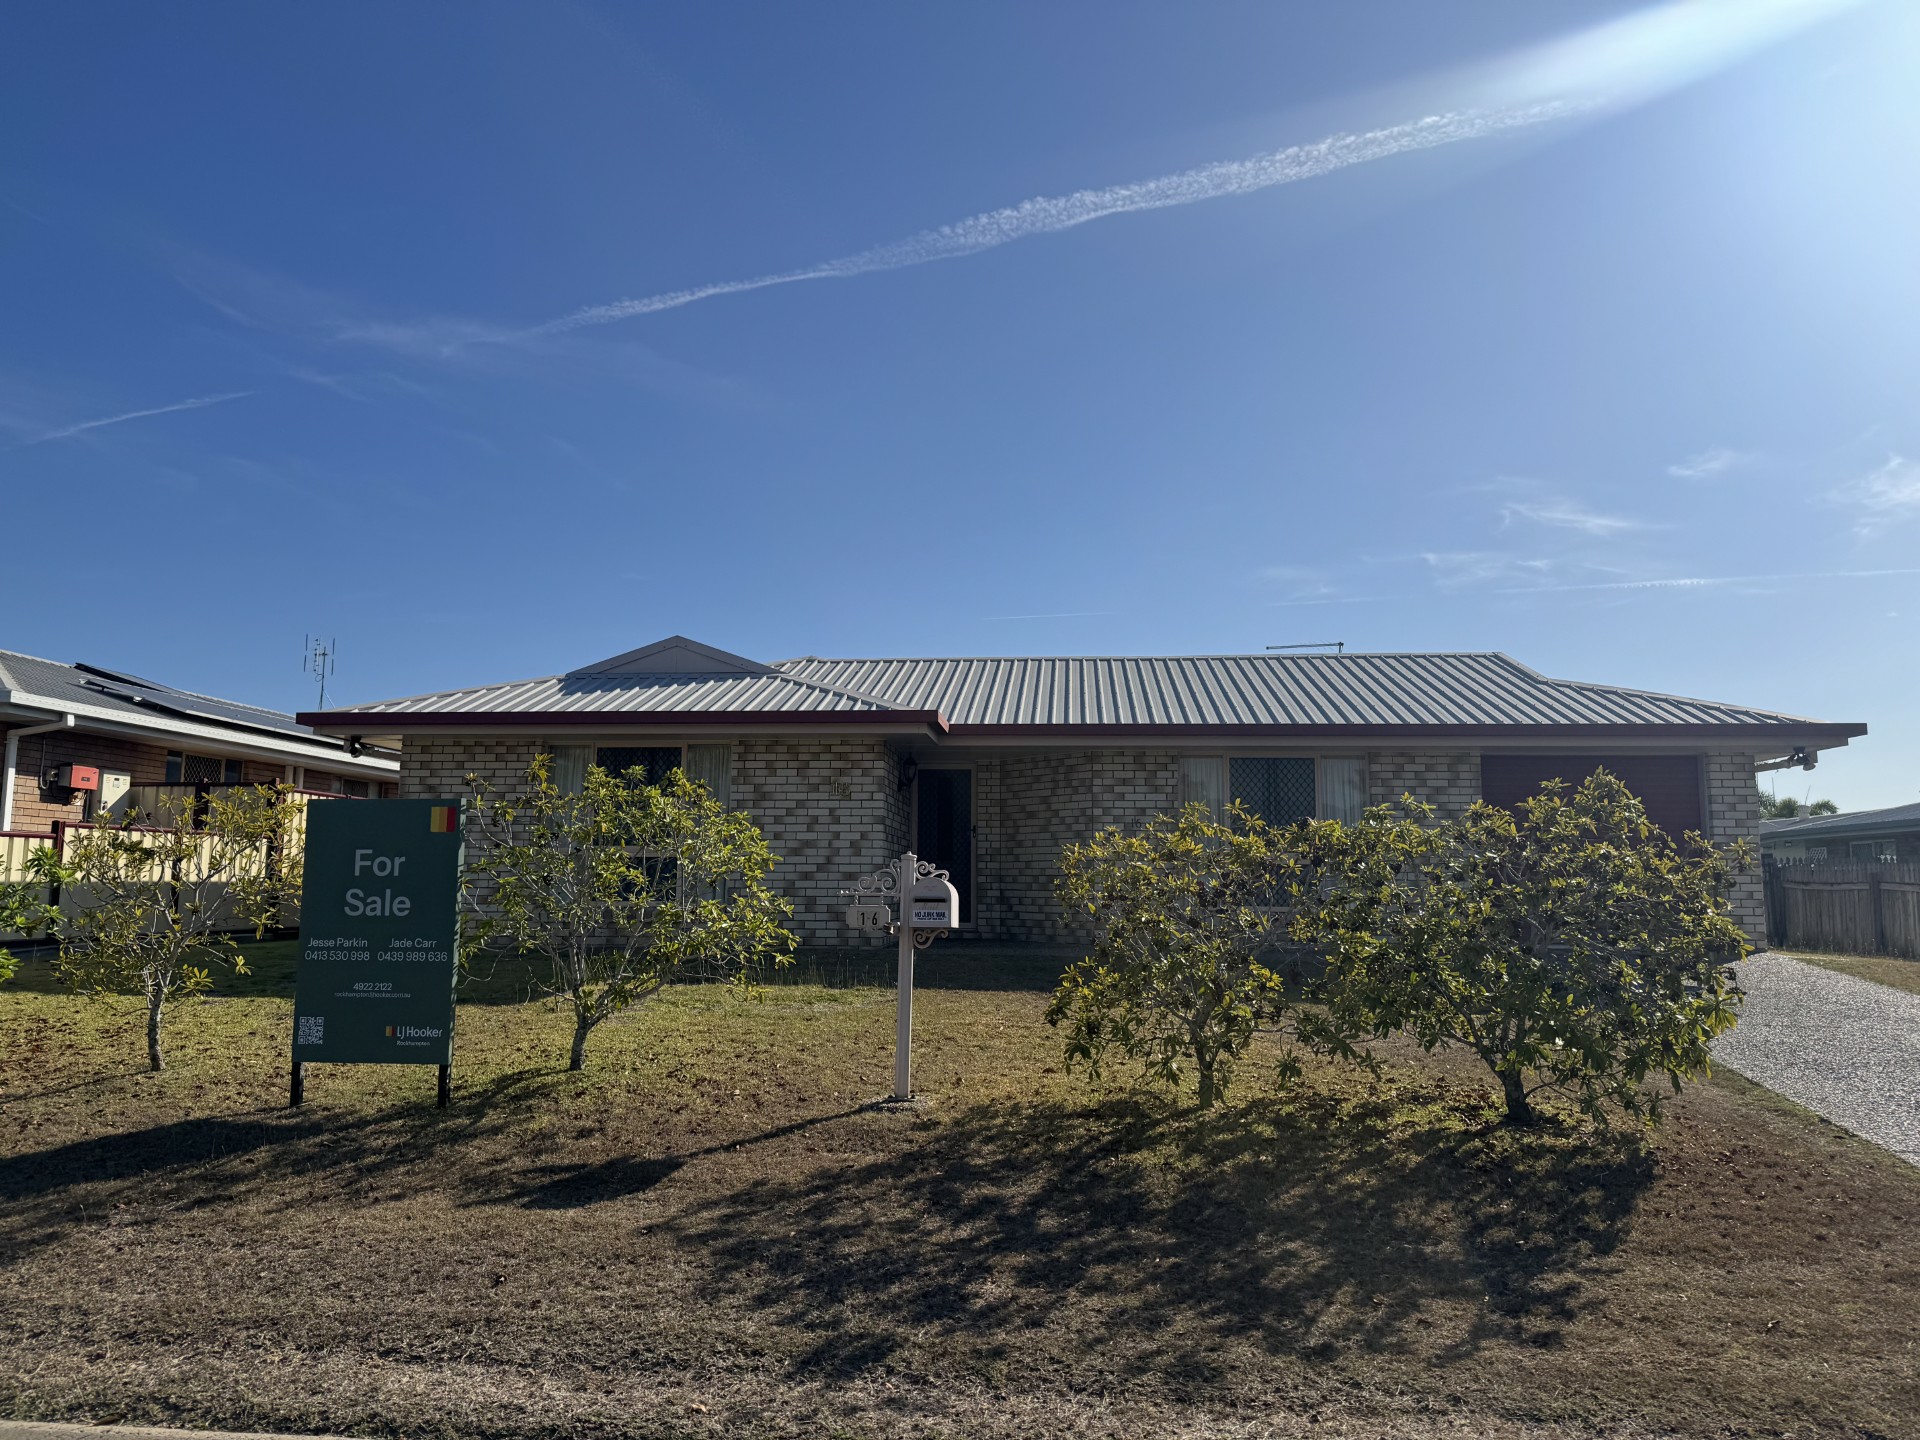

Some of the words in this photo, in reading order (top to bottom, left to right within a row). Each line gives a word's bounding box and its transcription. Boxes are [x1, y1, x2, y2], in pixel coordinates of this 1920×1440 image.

[1131, 818, 1142, 828] 16
[354, 849, 406, 877] For
[344, 888, 410, 917] Sale
[308, 937, 335, 948] Jesse
[337, 937, 368, 948] Parkin
[389, 938, 413, 948] Jade
[414, 938, 438, 948] Carr
[304, 950, 328, 961] 0413
[329, 950, 349, 961] 530
[350, 951, 370, 961] 998
[377, 951, 403, 962] 0439
[405, 951, 426, 962] 989
[427, 951, 448, 962] 636
[353, 982, 373, 991] 4922
[374, 982, 393, 991] 2122
[397, 1026, 405, 1039] LJ
[406, 1026, 443, 1037] Hooker
